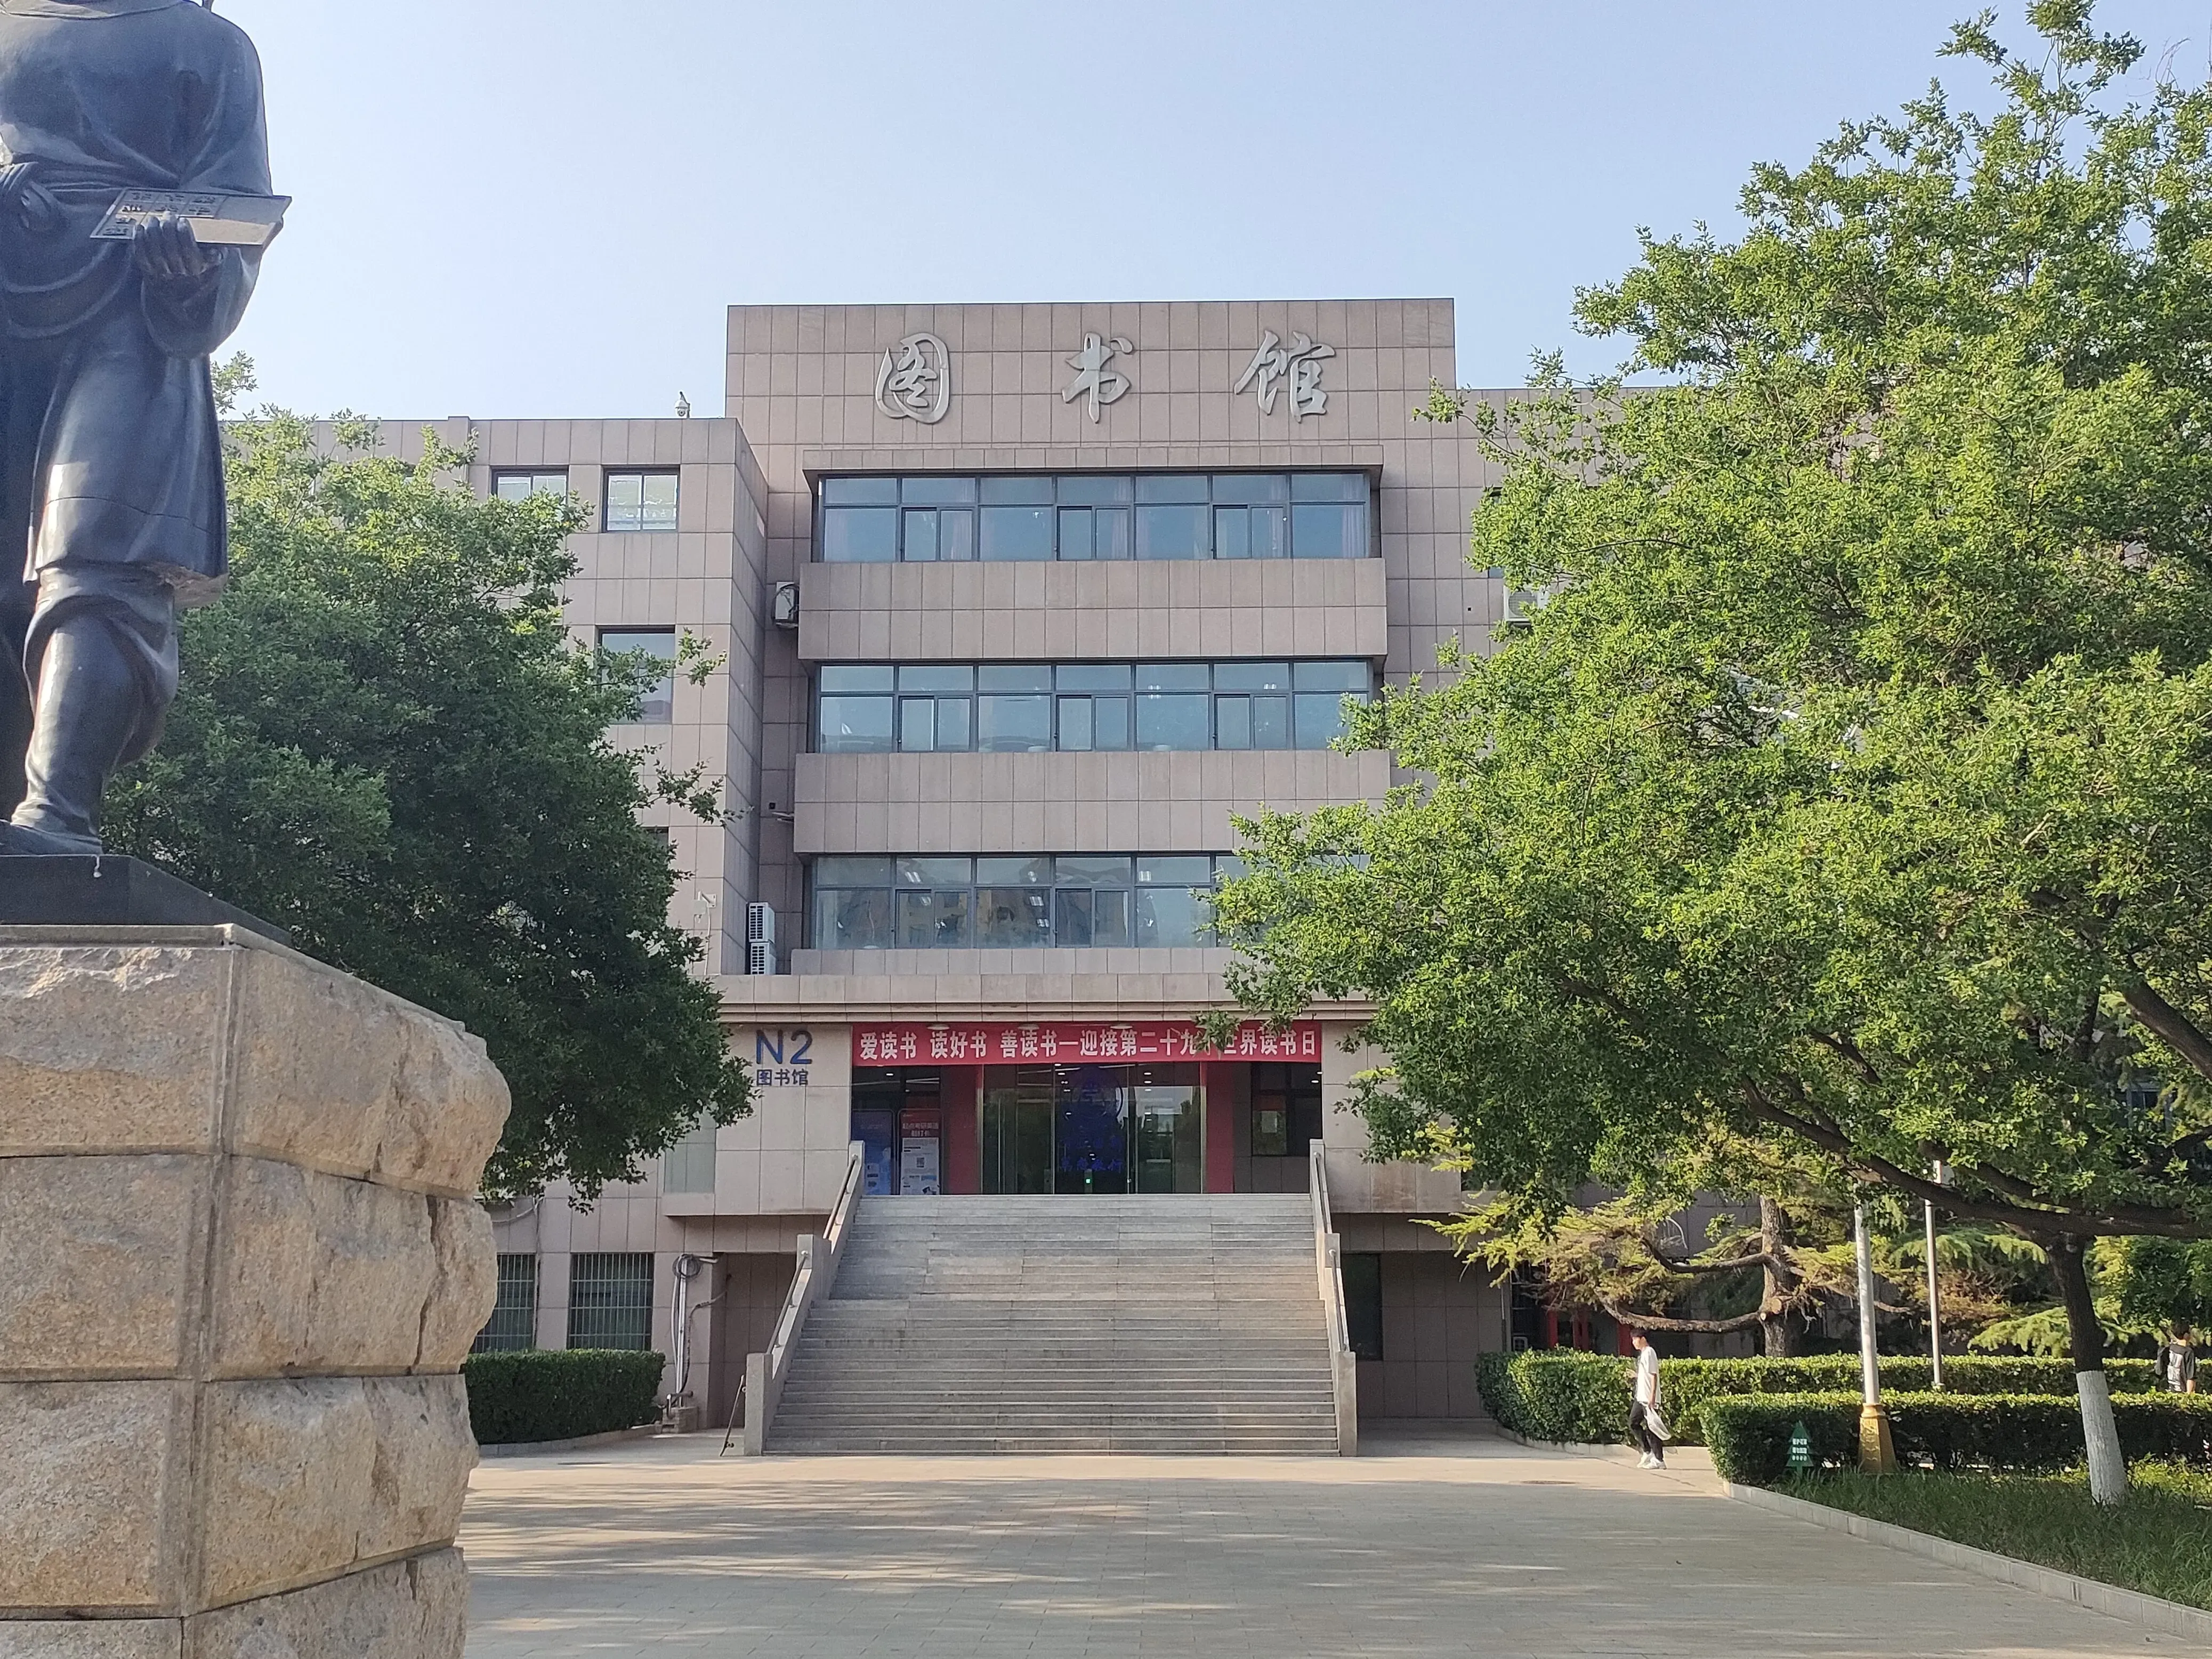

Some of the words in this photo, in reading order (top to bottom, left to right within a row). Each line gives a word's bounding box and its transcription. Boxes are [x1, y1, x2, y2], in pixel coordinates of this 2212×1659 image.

[874, 329, 1337, 425] 图书馆
[756, 1029, 813, 1064] N2
[860, 1030, 917, 1060] 爱读书
[930, 1030, 987, 1059] 读好书
[756, 1068, 809, 1086] 图书馆
